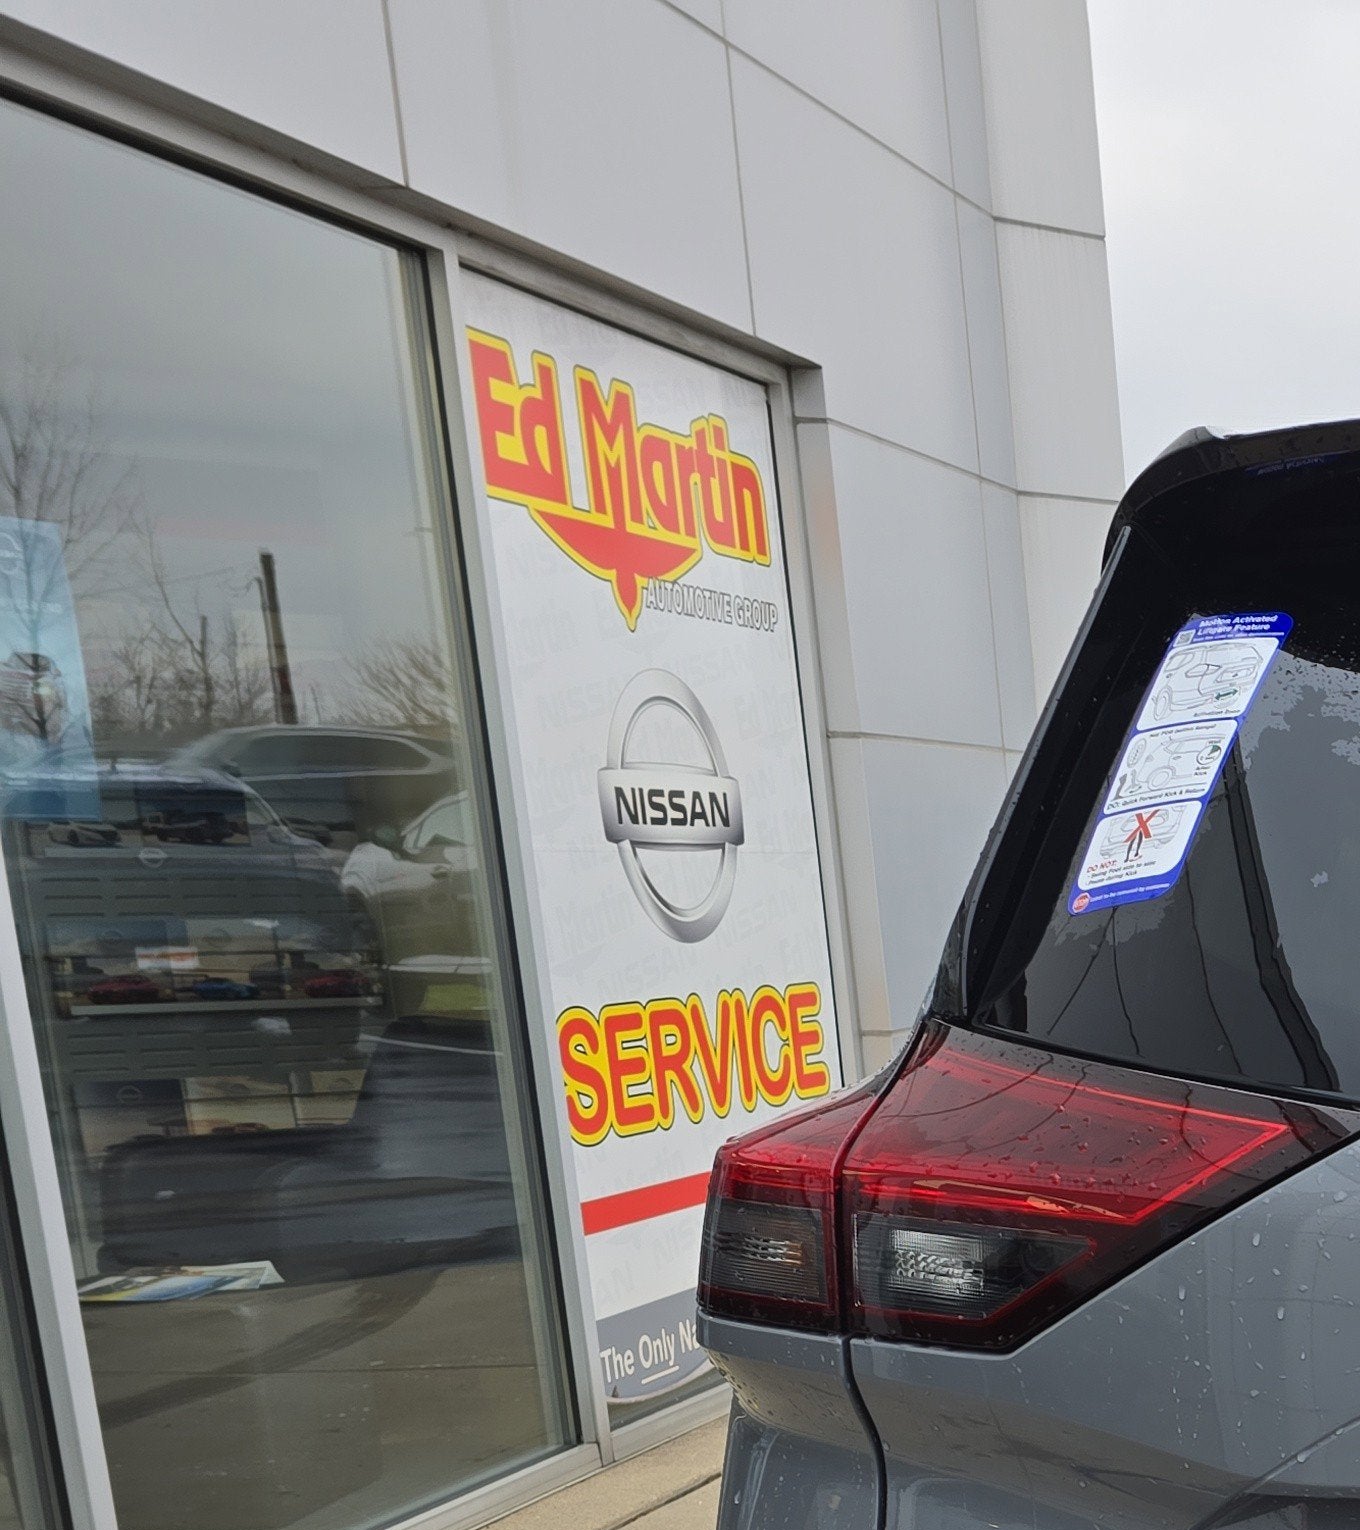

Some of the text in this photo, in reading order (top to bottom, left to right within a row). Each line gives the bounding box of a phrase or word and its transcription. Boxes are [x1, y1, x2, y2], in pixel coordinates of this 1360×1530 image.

[466, 325, 771, 566] Ed Martin
[645, 577, 778, 632] AUTOMOTIVE GROUP
[614, 786, 730, 828] NISSAN
[556, 982, 829, 1146] SERVICE
[600, 1346, 635, 1384] The
[638, 1327, 677, 1368] Only
